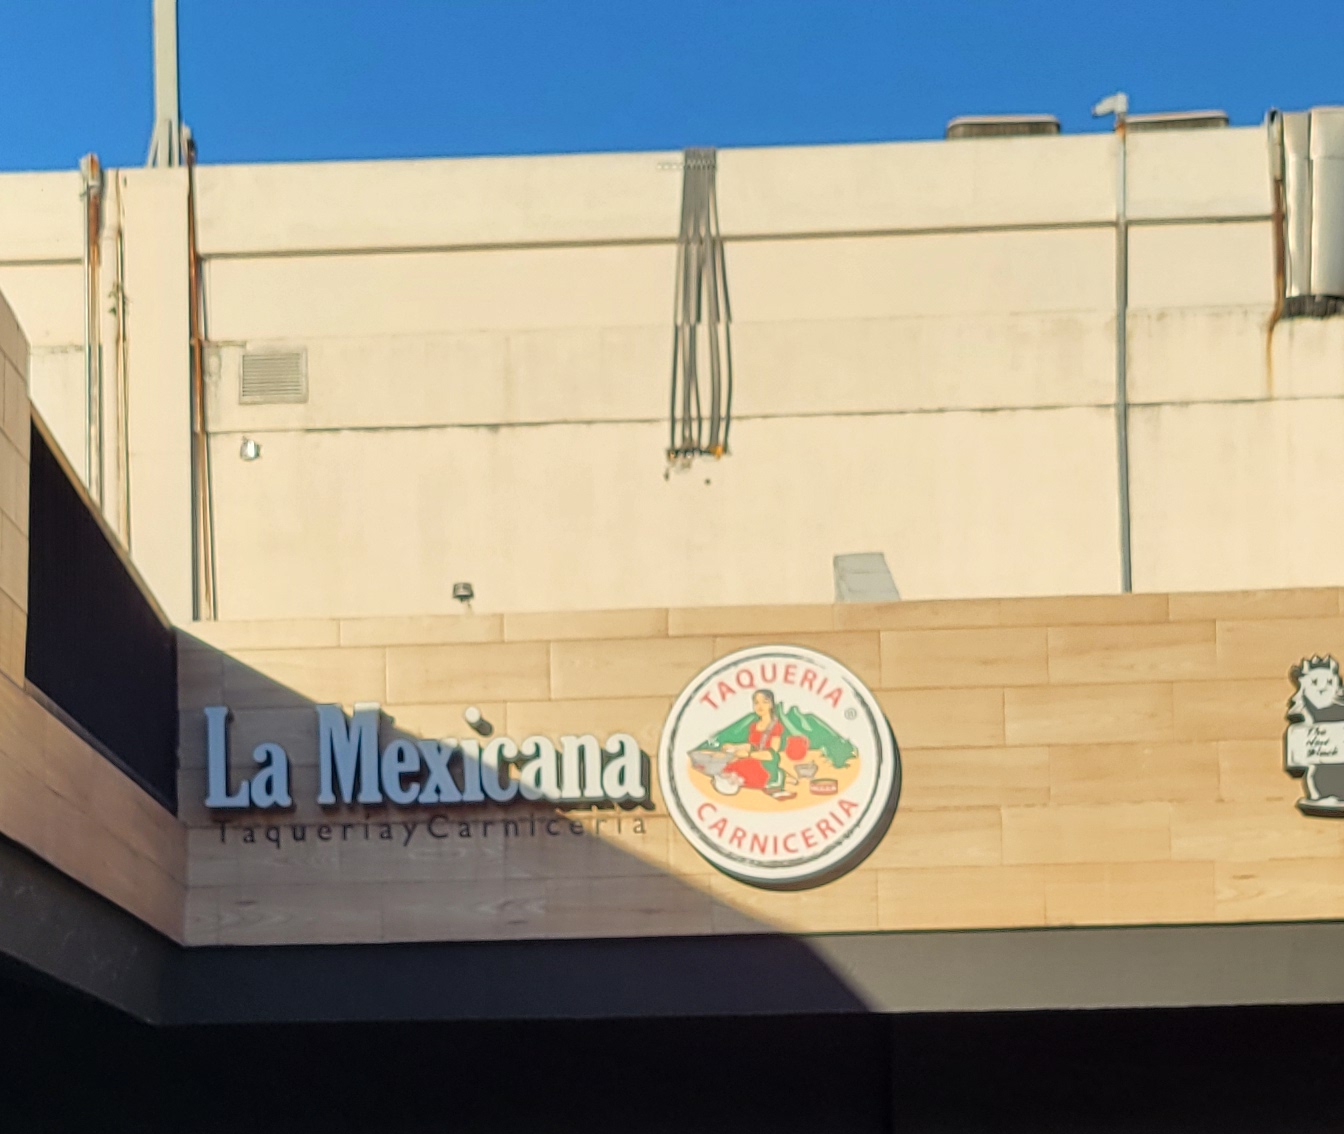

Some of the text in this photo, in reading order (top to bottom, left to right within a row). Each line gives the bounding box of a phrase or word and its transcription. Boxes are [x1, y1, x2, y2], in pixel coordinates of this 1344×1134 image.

[699, 663, 844, 711] TAQUERIA
[204, 701, 646, 810] La Mexicana
[697, 797, 859, 855] CARNICERIA
